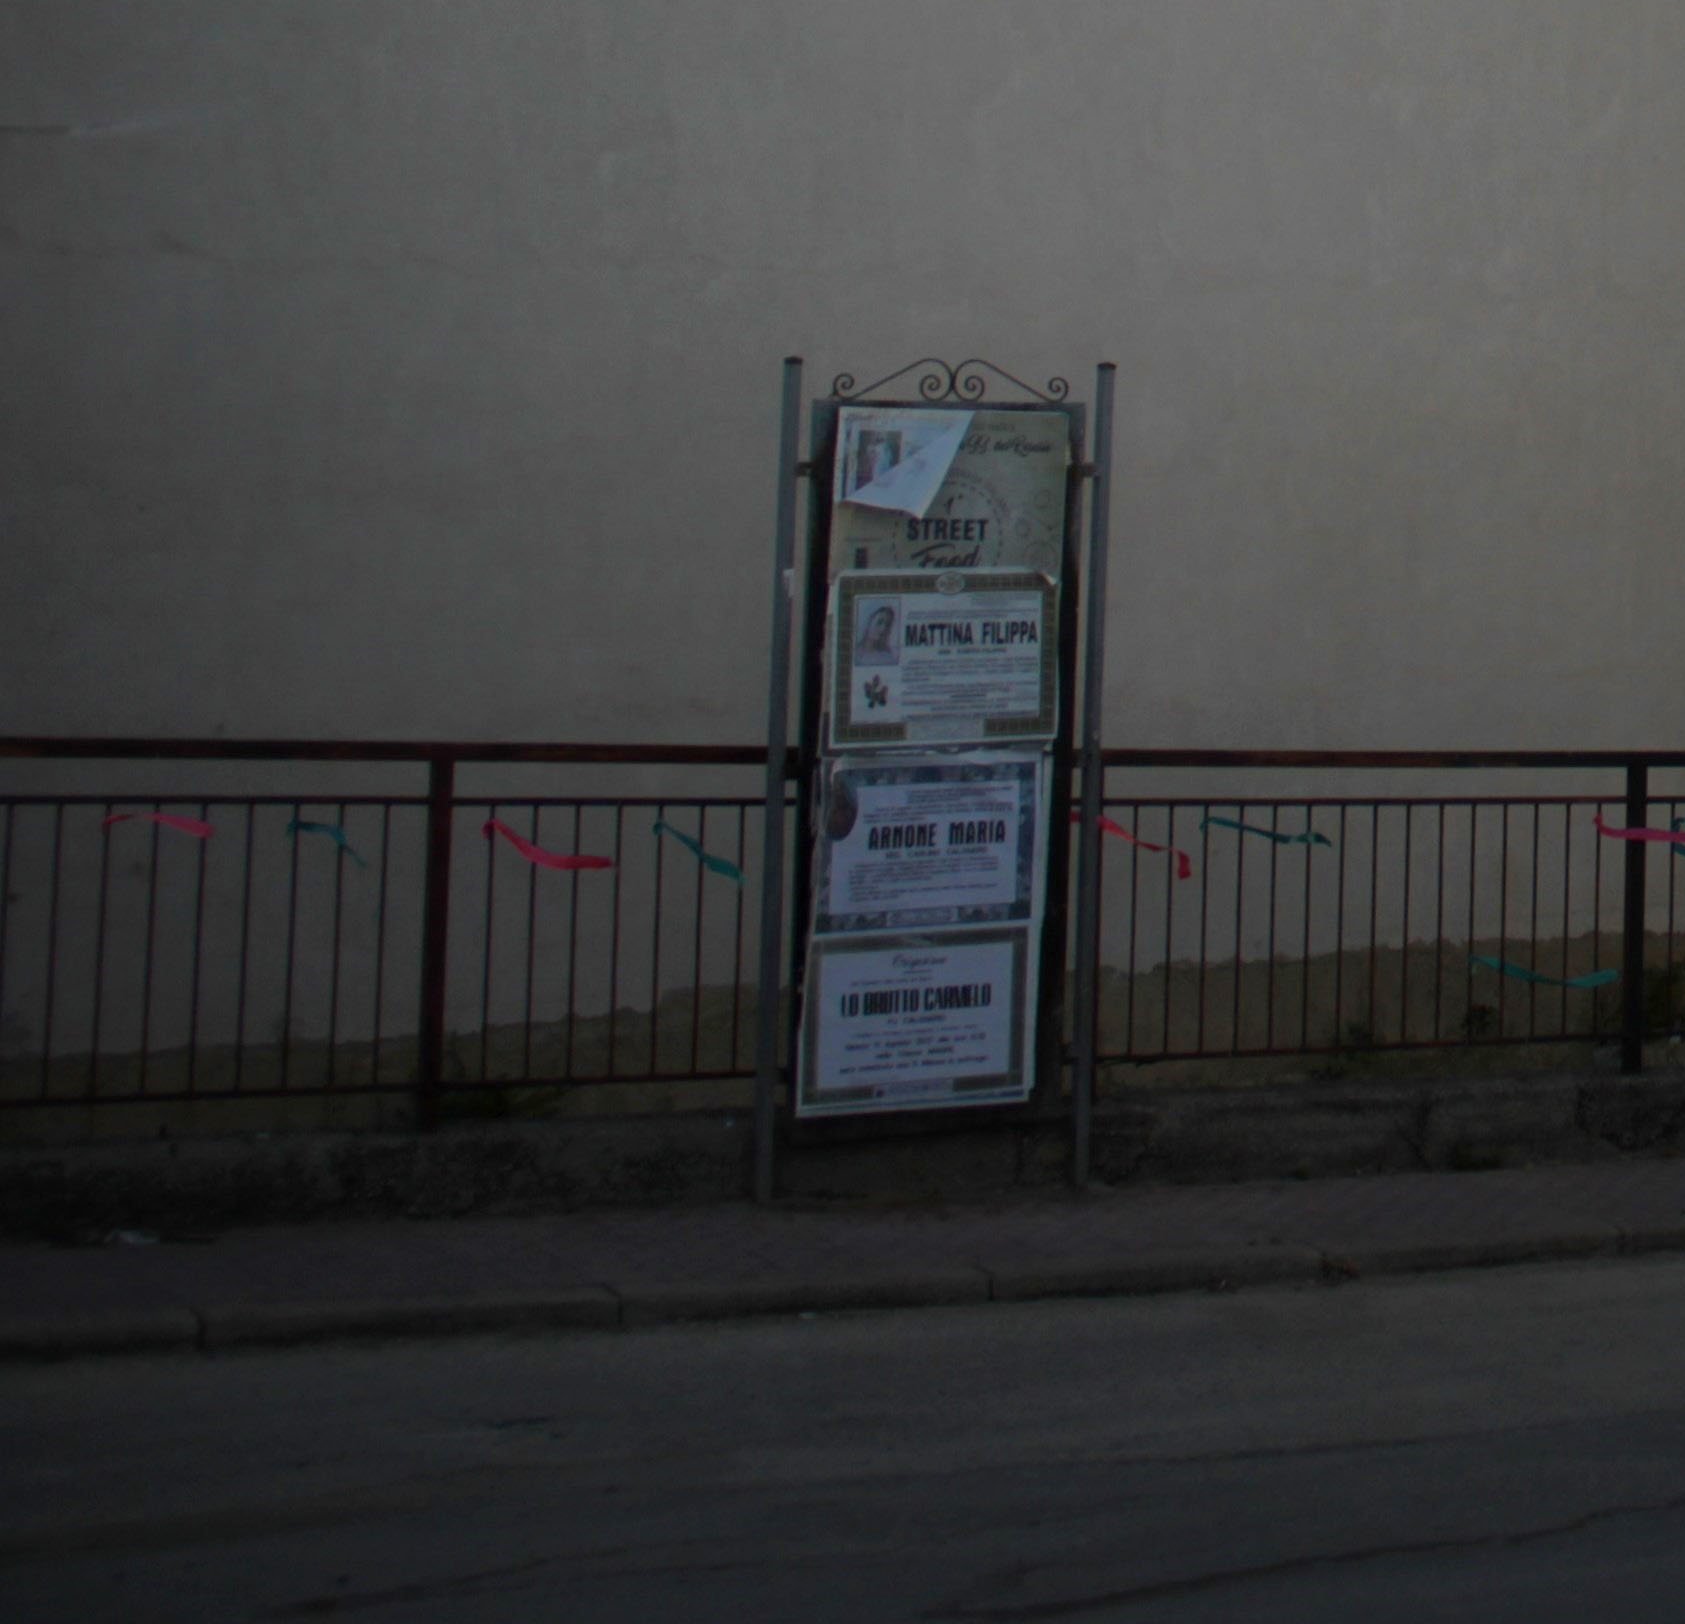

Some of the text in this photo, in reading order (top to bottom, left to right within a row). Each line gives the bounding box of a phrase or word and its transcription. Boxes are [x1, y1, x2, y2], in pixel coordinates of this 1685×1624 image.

[906, 518, 989, 541] STREET
[910, 543, 981, 568] Food
[905, 620, 1038, 647] MATTINA FILIPPA
[868, 820, 1006, 850] ARNONE MARIA
[841, 993, 860, 1017] LO
[924, 983, 992, 1011] CARMELO
